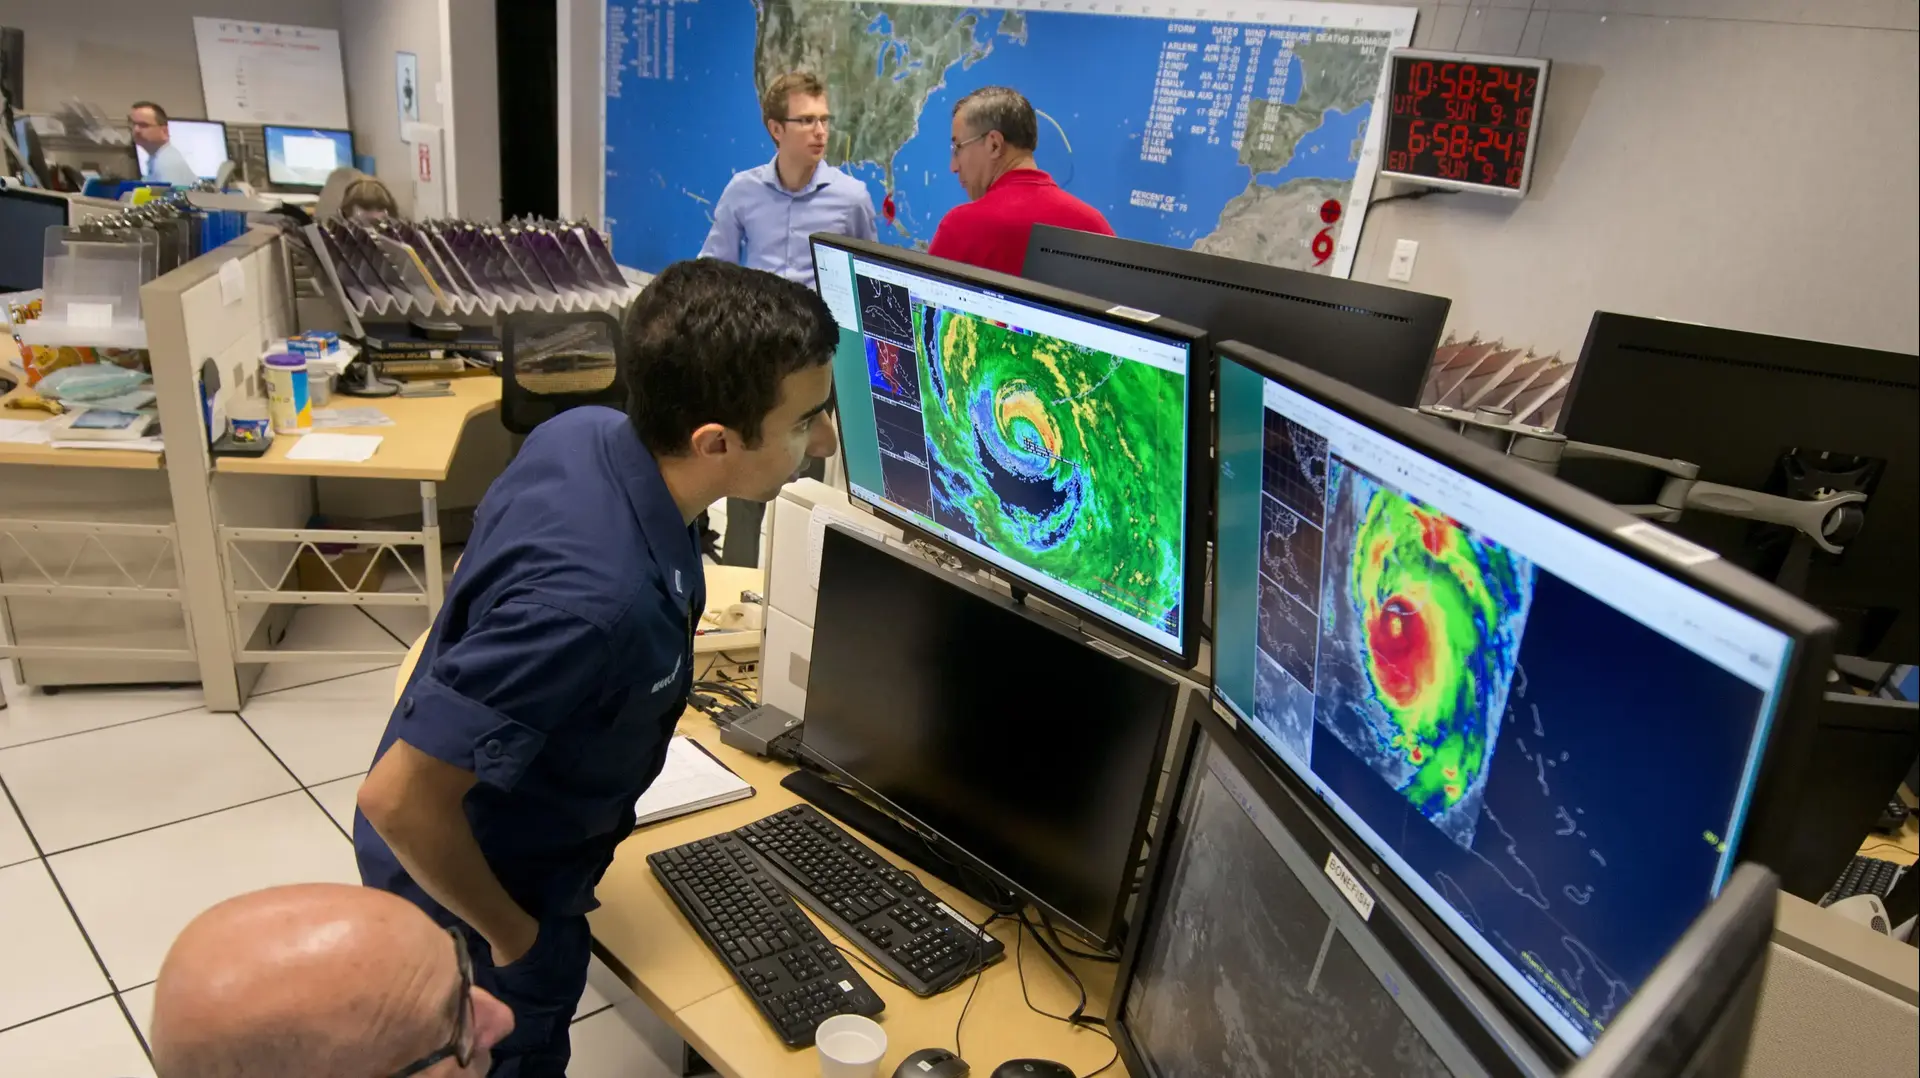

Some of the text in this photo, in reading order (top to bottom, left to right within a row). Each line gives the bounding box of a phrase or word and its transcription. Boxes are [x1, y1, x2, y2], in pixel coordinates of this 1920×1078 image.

[1168, 24, 1390, 47] STORM DATES WIND PRESSURE DEATHS DAMAGE
[1216, 35, 1233, 44] UTC
[1167, 42, 1199, 52] ARLENE
[1166, 51, 1187, 61] BRET
[1203, 53, 1220, 63] JUN
[1164, 61, 1189, 72] CINDY
[1163, 69, 1180, 79] DON
[1199, 71, 1213, 80] JUL
[1161, 78, 1185, 88] EMILY
[1408, 62, 1523, 103] 10:58:24
[1159, 87, 1196, 99] FRANKLIN
[1197, 91, 1214, 100] AUG
[1156, 105, 1187, 116] HARVEY
[1393, 94, 1424, 117] UTC
[1445, 99, 1478, 122] SUN
[1515, 106, 1533, 128] 10
[1155, 112, 1174, 122] IRMA
[1153, 121, 1173, 131] JOSE
[1190, 125, 1206, 134] SEP
[1152, 129, 1174, 140] KATIA
[1150, 138, 1166, 147] LEE
[1407, 119, 1514, 162] 6:58:24
[1149, 146, 1172, 157] MARIA
[1147, 154, 1167, 164] NATE
[1388, 150, 1417, 171] EDT
[1437, 156, 1469, 180] SUN
[1505, 166, 1522, 187] 10
[1131, 189, 1176, 204] PERCENT OF
[1130, 197, 1158, 209] MEDIAN
[1159, 202, 1174, 213] ACE
[1329, 858, 1371, 912] BONEFISH
